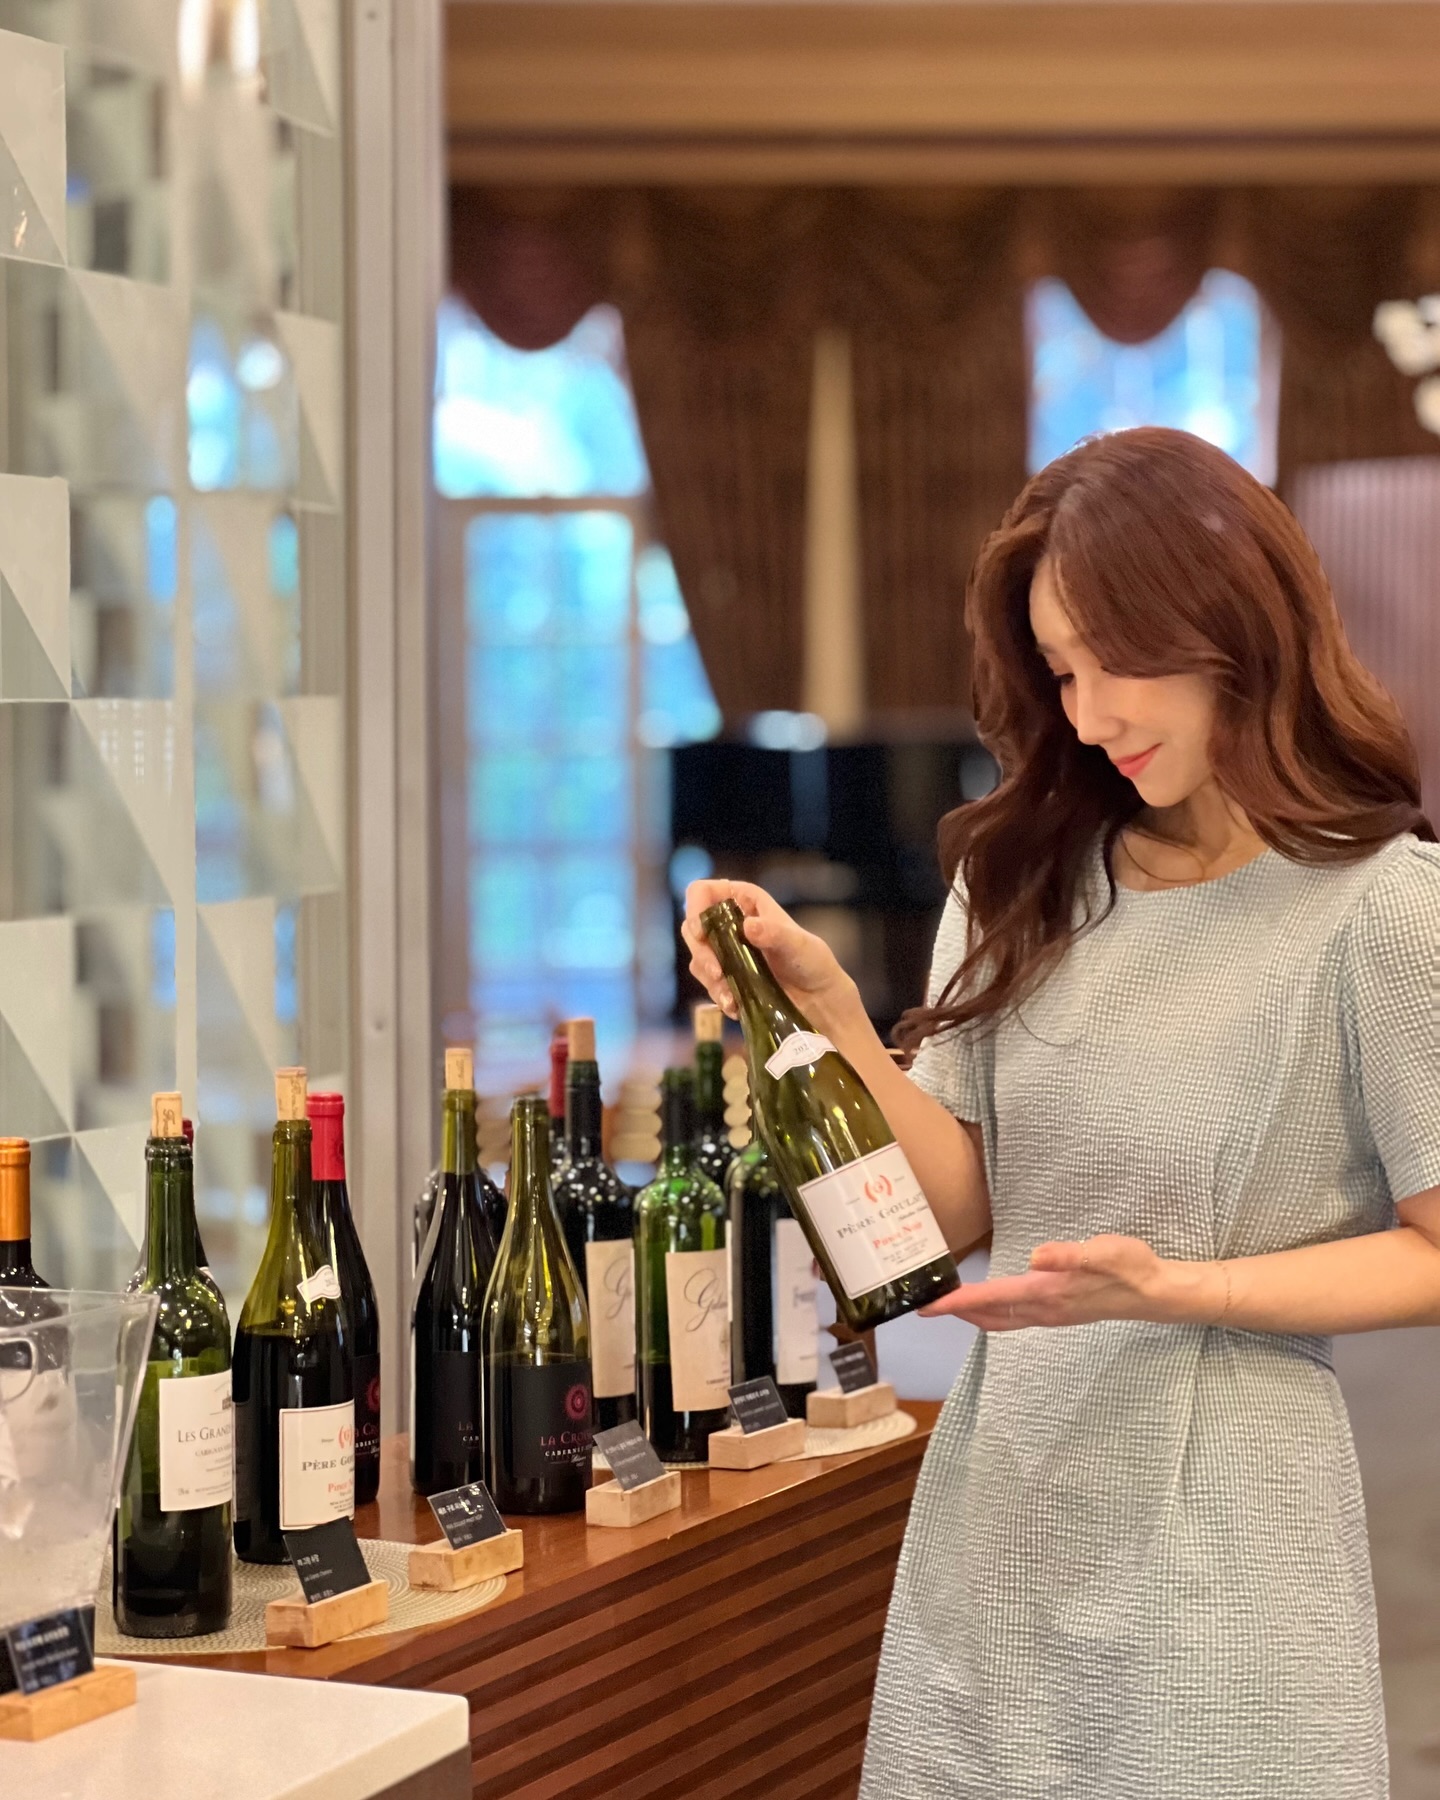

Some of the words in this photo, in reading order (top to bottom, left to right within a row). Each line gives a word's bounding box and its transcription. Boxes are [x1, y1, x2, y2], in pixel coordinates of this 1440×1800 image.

[177, 1429, 196, 1443] LES
[540, 1435, 556, 1446] LA
[300, 1459, 337, 1472] PÈRE
